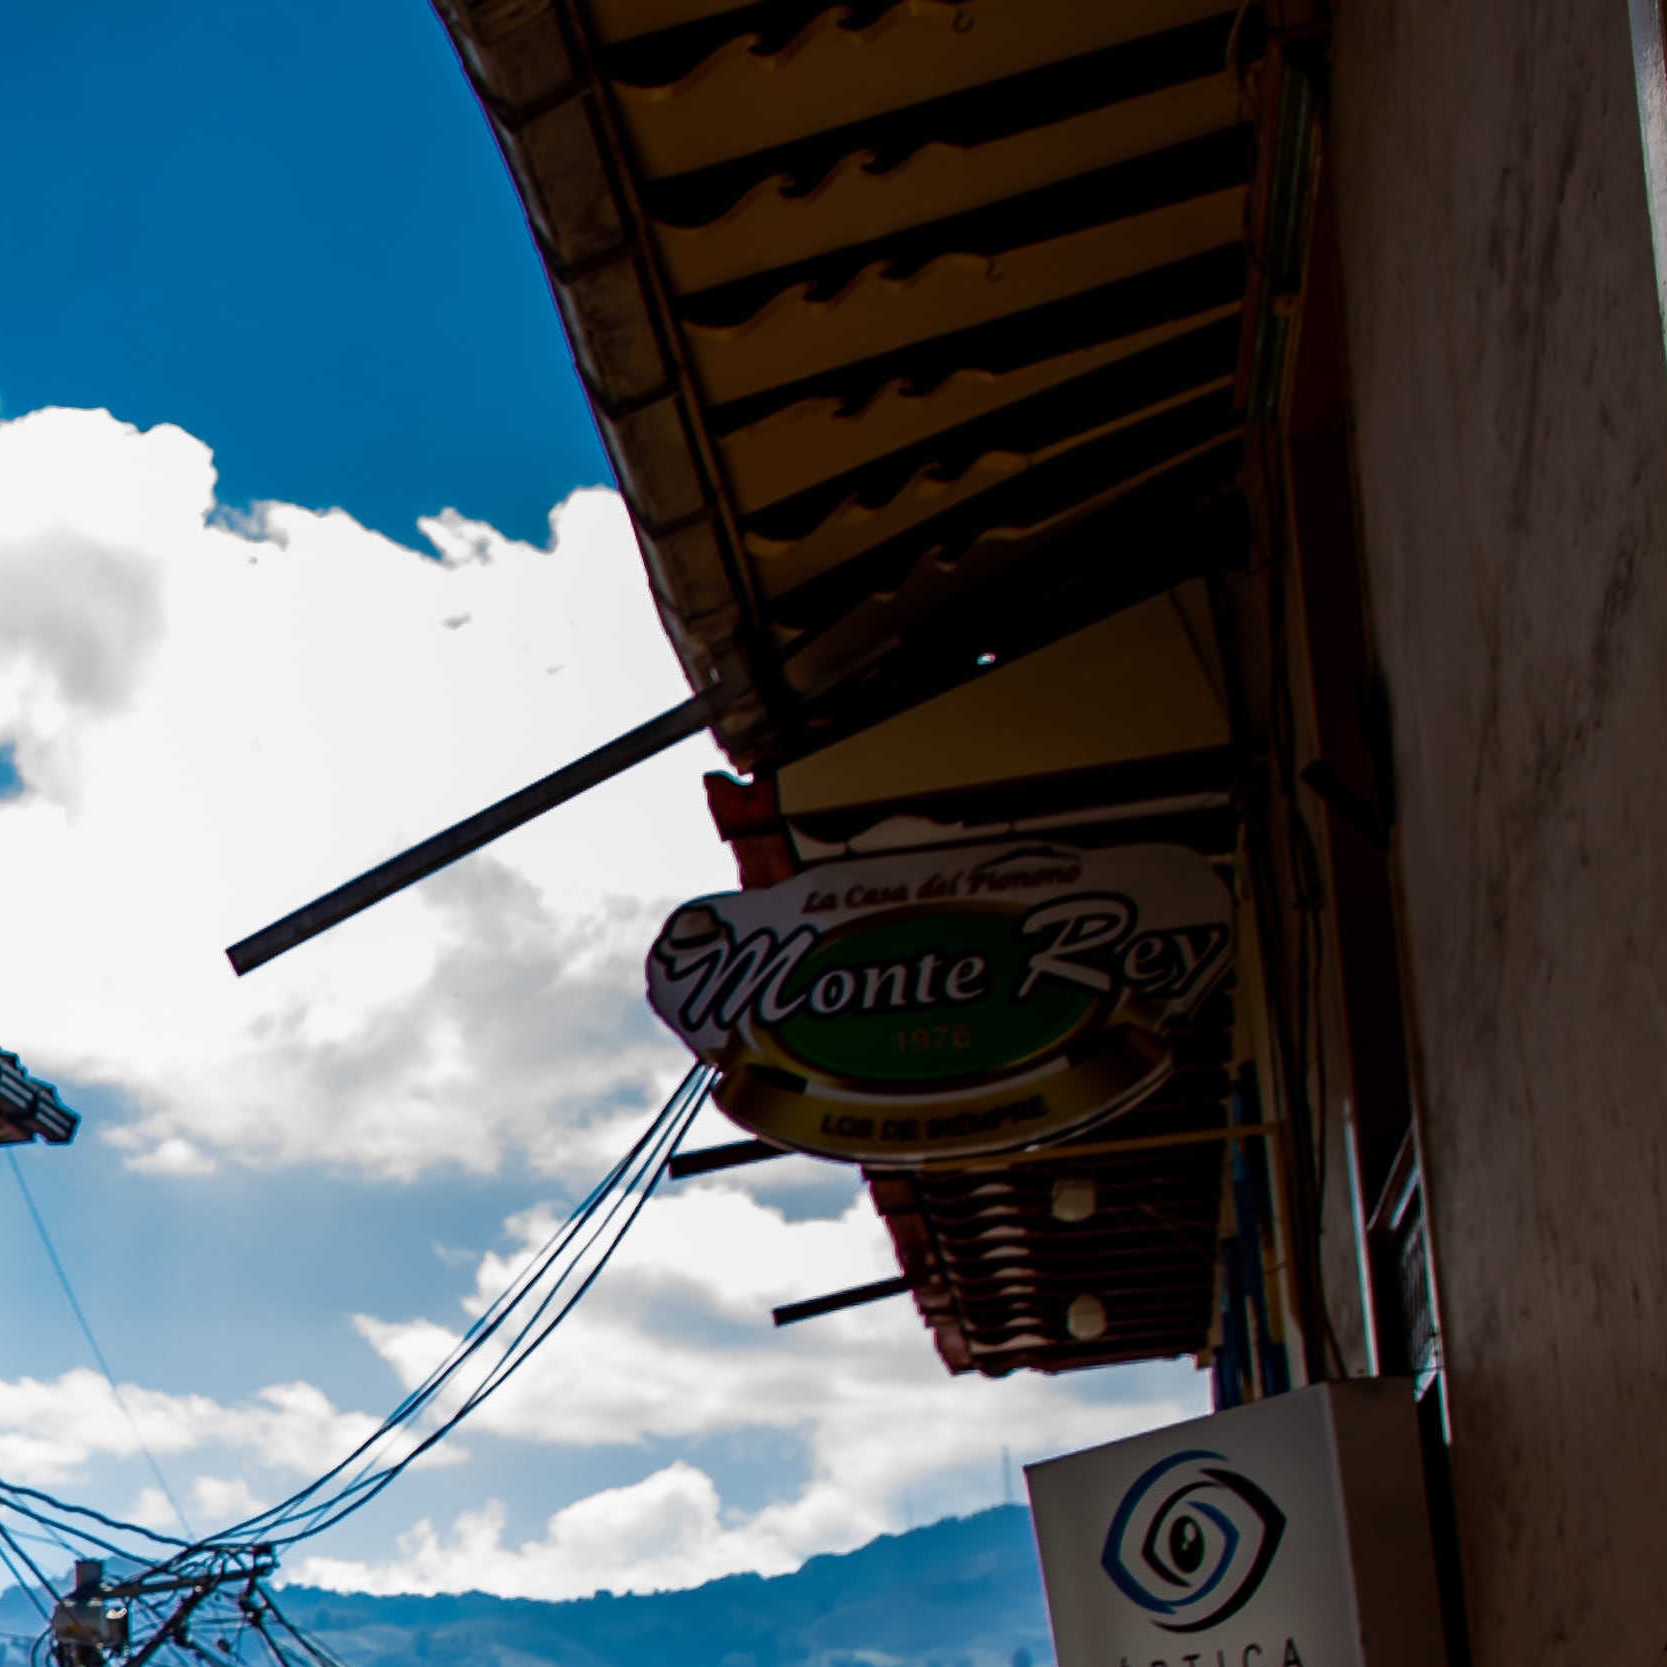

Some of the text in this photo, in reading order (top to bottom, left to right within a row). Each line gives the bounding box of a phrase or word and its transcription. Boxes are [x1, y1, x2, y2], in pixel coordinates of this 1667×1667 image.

[802, 862, 1082, 914] La Casa del Pionono
[670, 892, 1229, 1029] Monte Rey
[893, 1024, 973, 1054] 1976
[821, 1110, 874, 1140] LOS
[880, 1114, 920, 1141] DE
